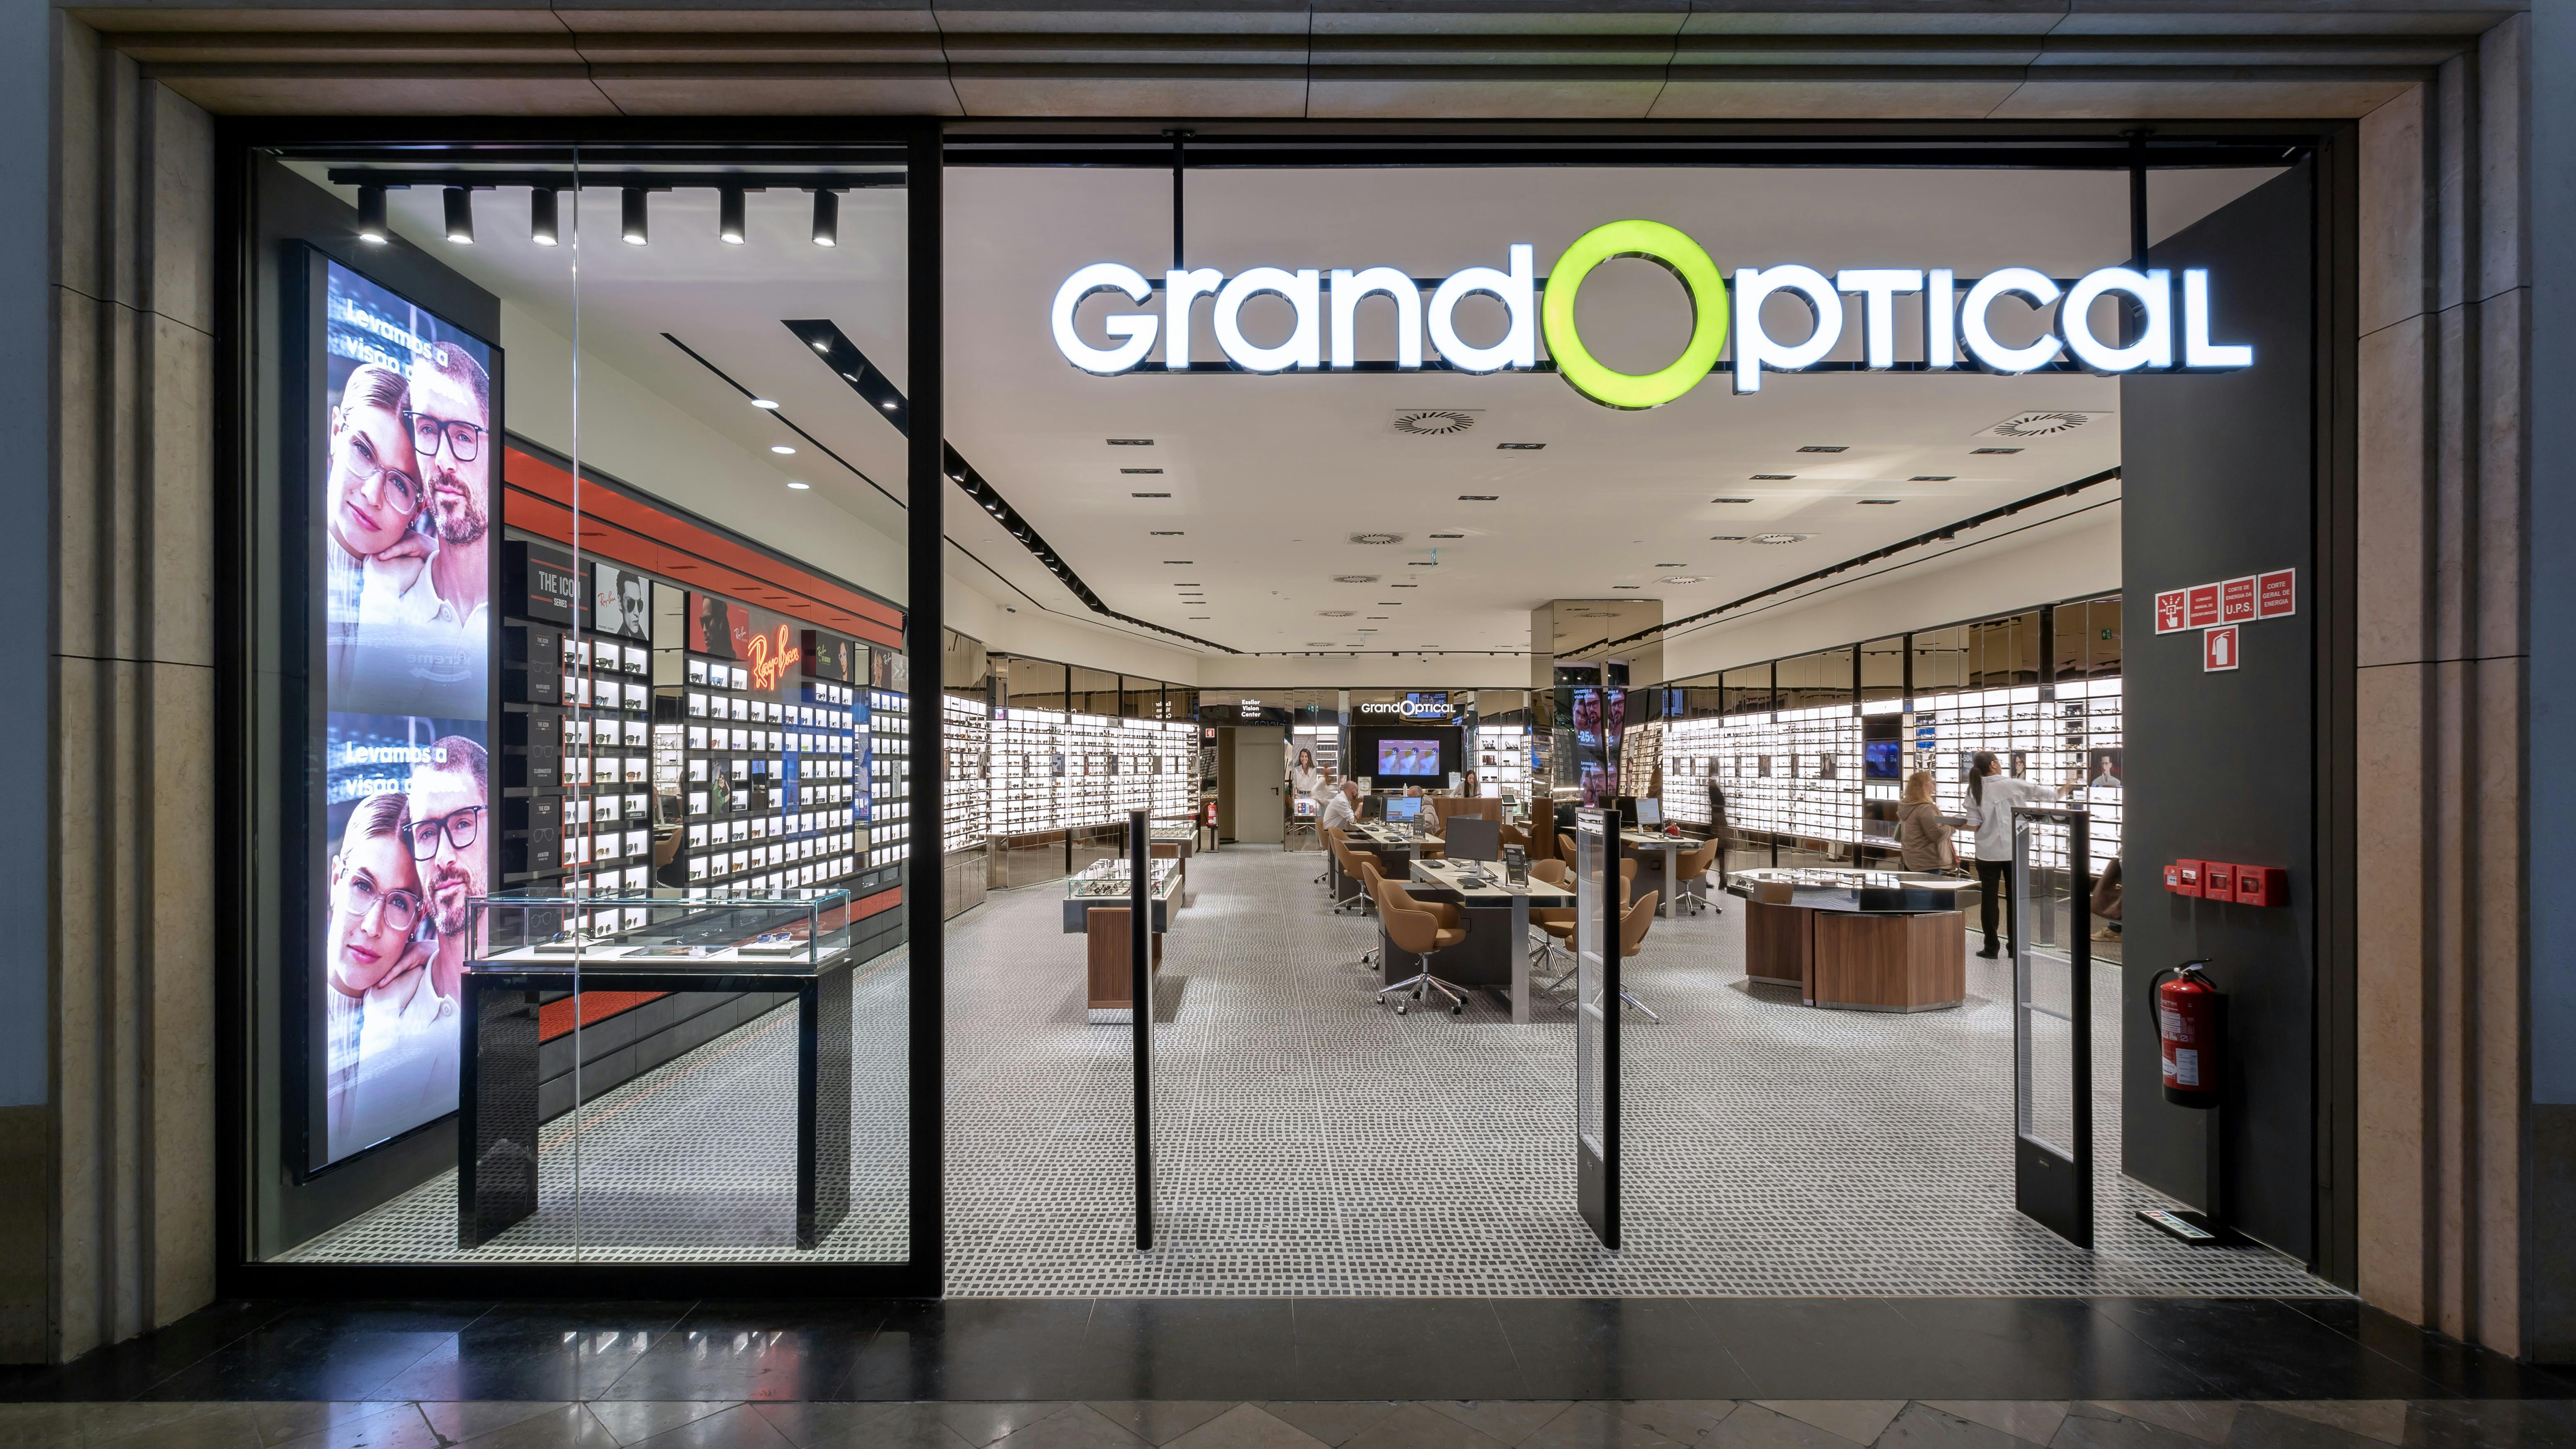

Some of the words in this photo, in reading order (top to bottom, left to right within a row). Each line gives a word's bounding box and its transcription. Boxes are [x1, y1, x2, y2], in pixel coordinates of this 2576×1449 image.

[346, 298, 432, 359] Levamos
[437, 349, 448, 368] a
[346, 336, 400, 374] visão
[538, 571, 557, 593] THE
[2267, 581, 2286, 590] CORTE
[554, 598, 568, 608] SERIES
[2226, 602, 2253, 615] U.P.S.
[2264, 599, 2289, 607] ENERGIA
[1577, 731, 1595, 743] -25%
[346, 741, 432, 763] Levamos
[436, 747, 447, 763] a
[346, 773, 400, 795] visão
